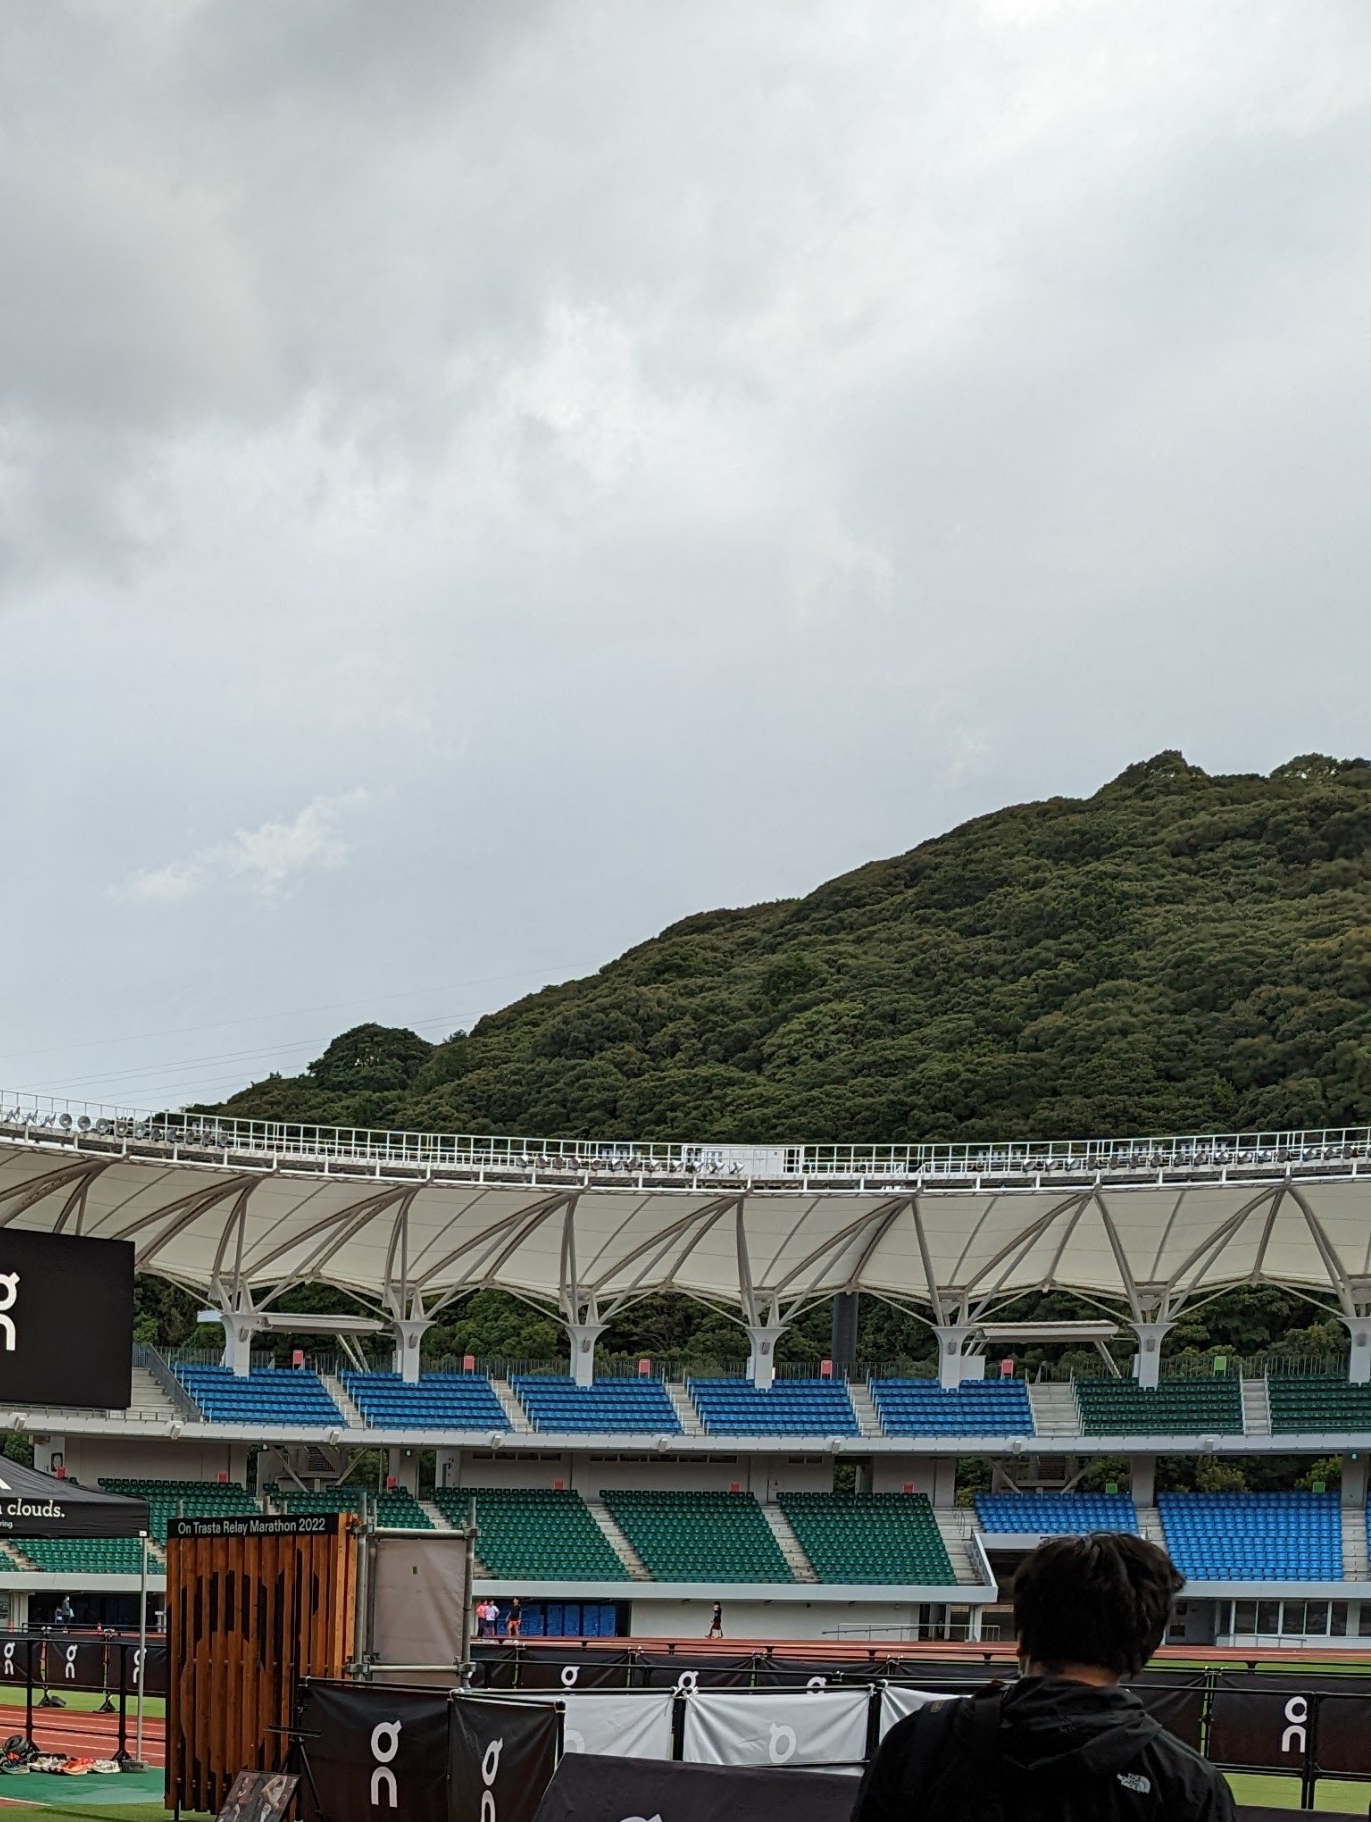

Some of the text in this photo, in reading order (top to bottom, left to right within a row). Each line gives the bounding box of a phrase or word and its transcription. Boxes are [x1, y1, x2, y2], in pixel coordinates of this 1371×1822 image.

[7, 1498, 66, 1518] clouds.
[178, 1518, 326, 1536] On Trasta Relay Marathon 2022
